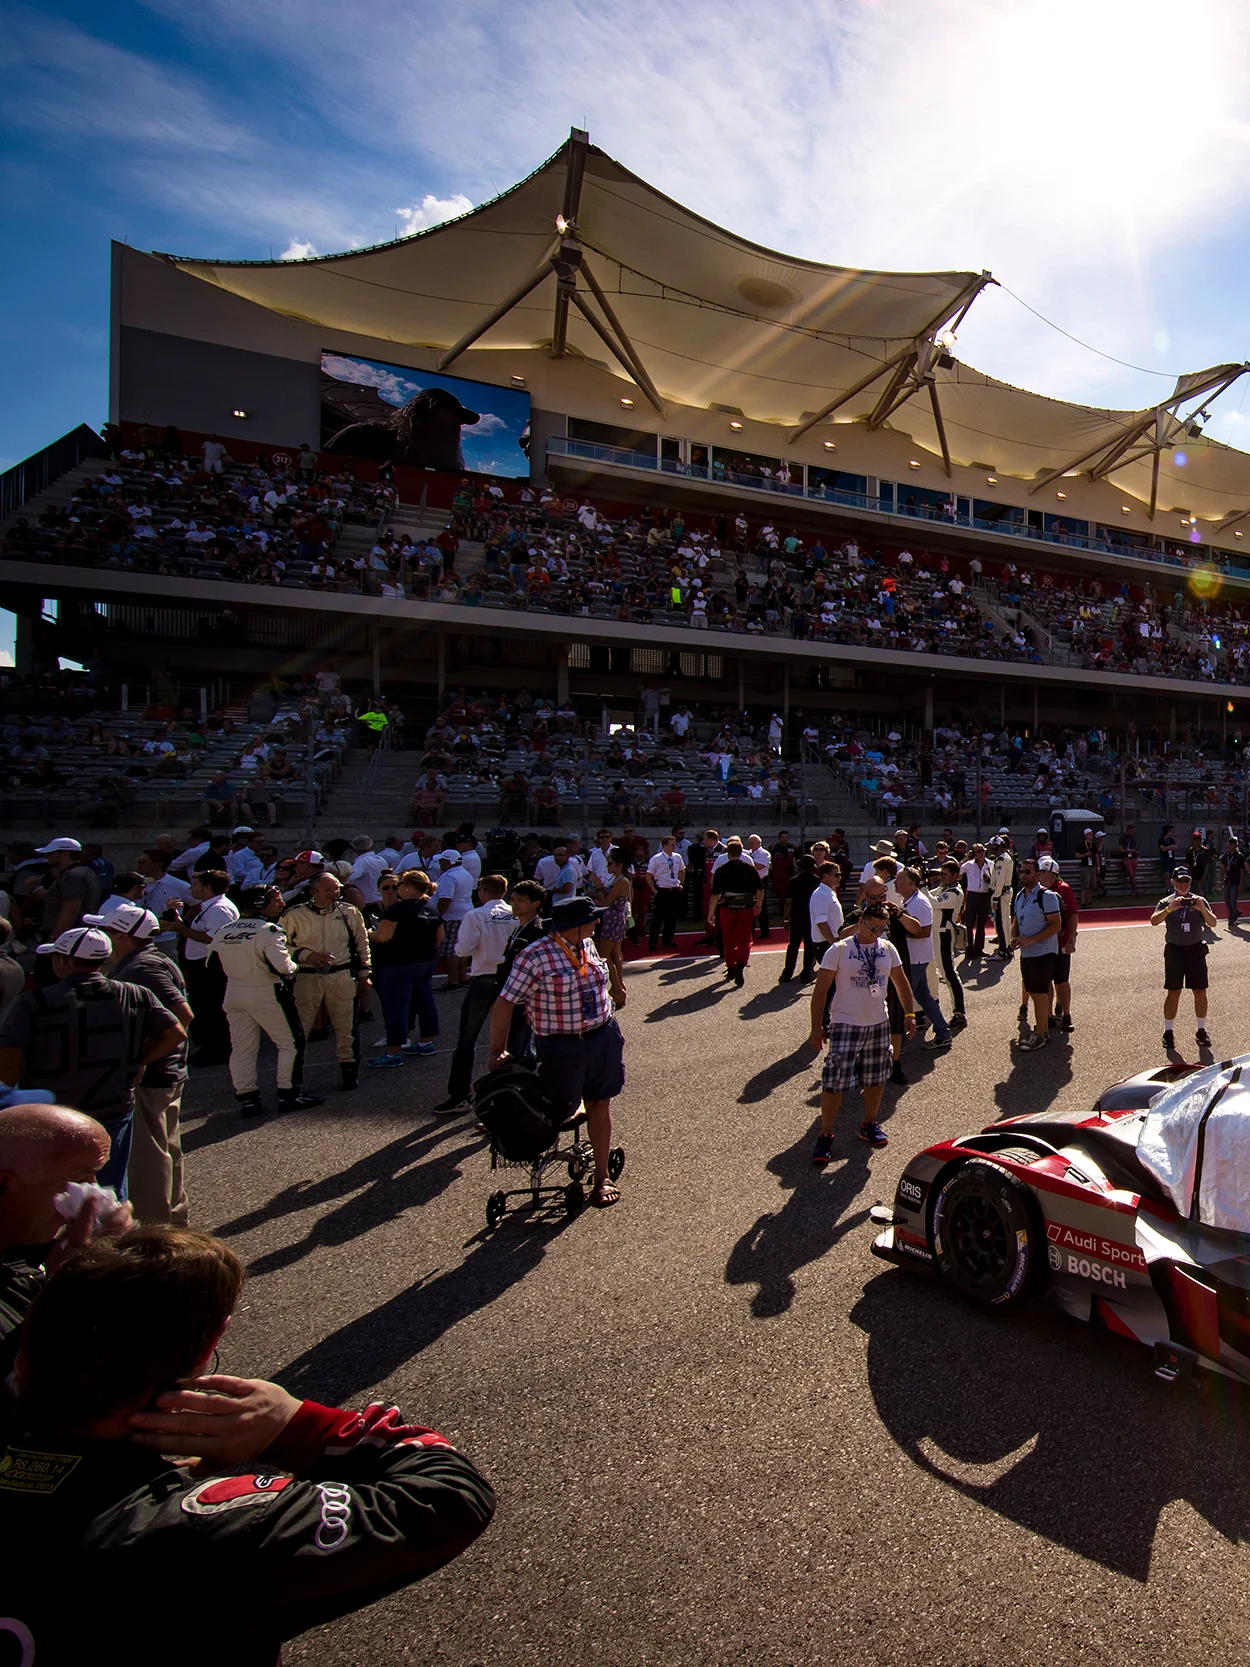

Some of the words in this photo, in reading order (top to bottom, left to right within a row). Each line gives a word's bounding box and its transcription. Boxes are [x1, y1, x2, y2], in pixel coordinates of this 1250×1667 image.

[901, 1180, 922, 1199] ORIS
[904, 1244, 933, 1260] MICHELIN
[1063, 1230, 1097, 1250] Audi
[1101, 1241, 1146, 1267] Sport
[1010, 1253, 1027, 1295] MICHELIN
[1067, 1255, 1126, 1289] BOSCH
